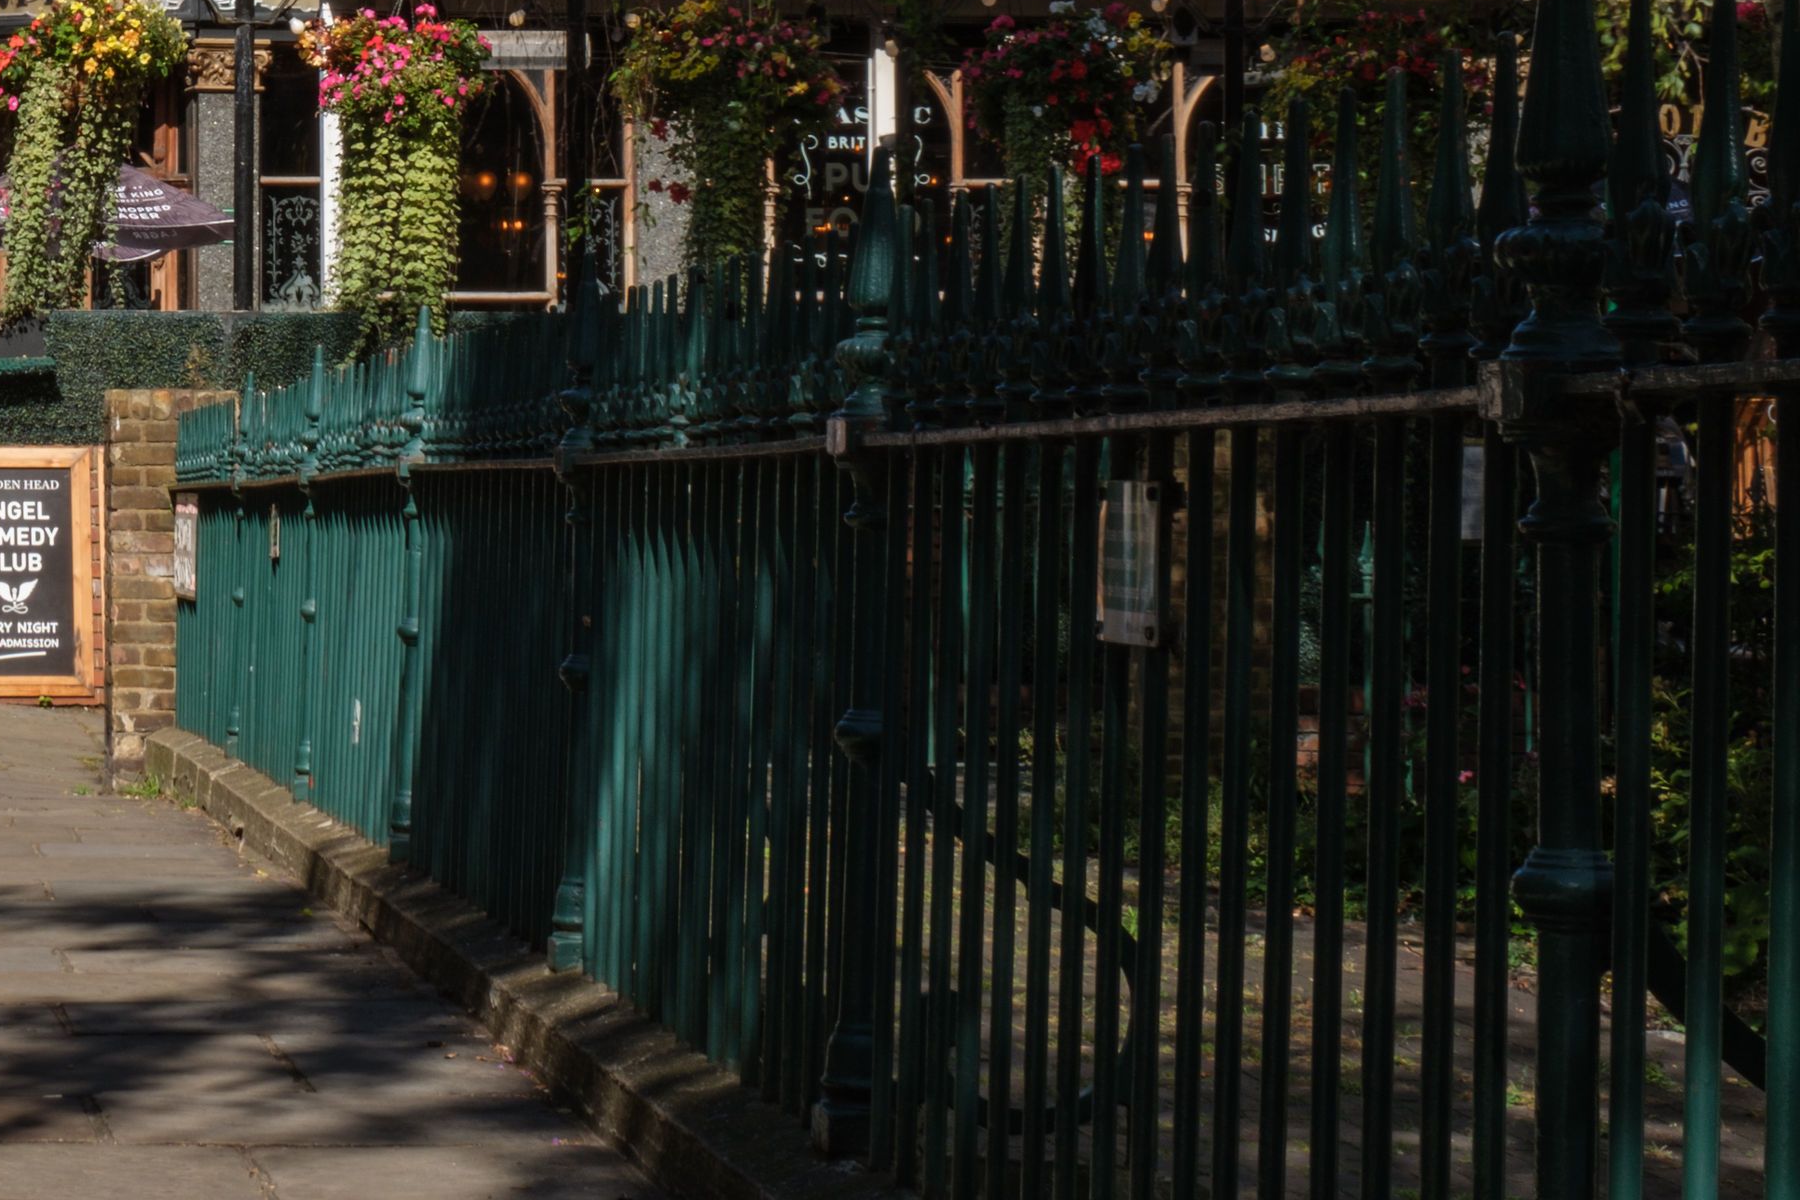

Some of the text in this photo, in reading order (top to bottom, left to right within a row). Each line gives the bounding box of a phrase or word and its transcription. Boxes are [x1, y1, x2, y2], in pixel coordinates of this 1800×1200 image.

[825, 162, 869, 193] PU
[23, 479, 60, 491] HEAD
[17, 621, 59, 634] NIGHT
[0, 637, 60, 648] ADMISSION
